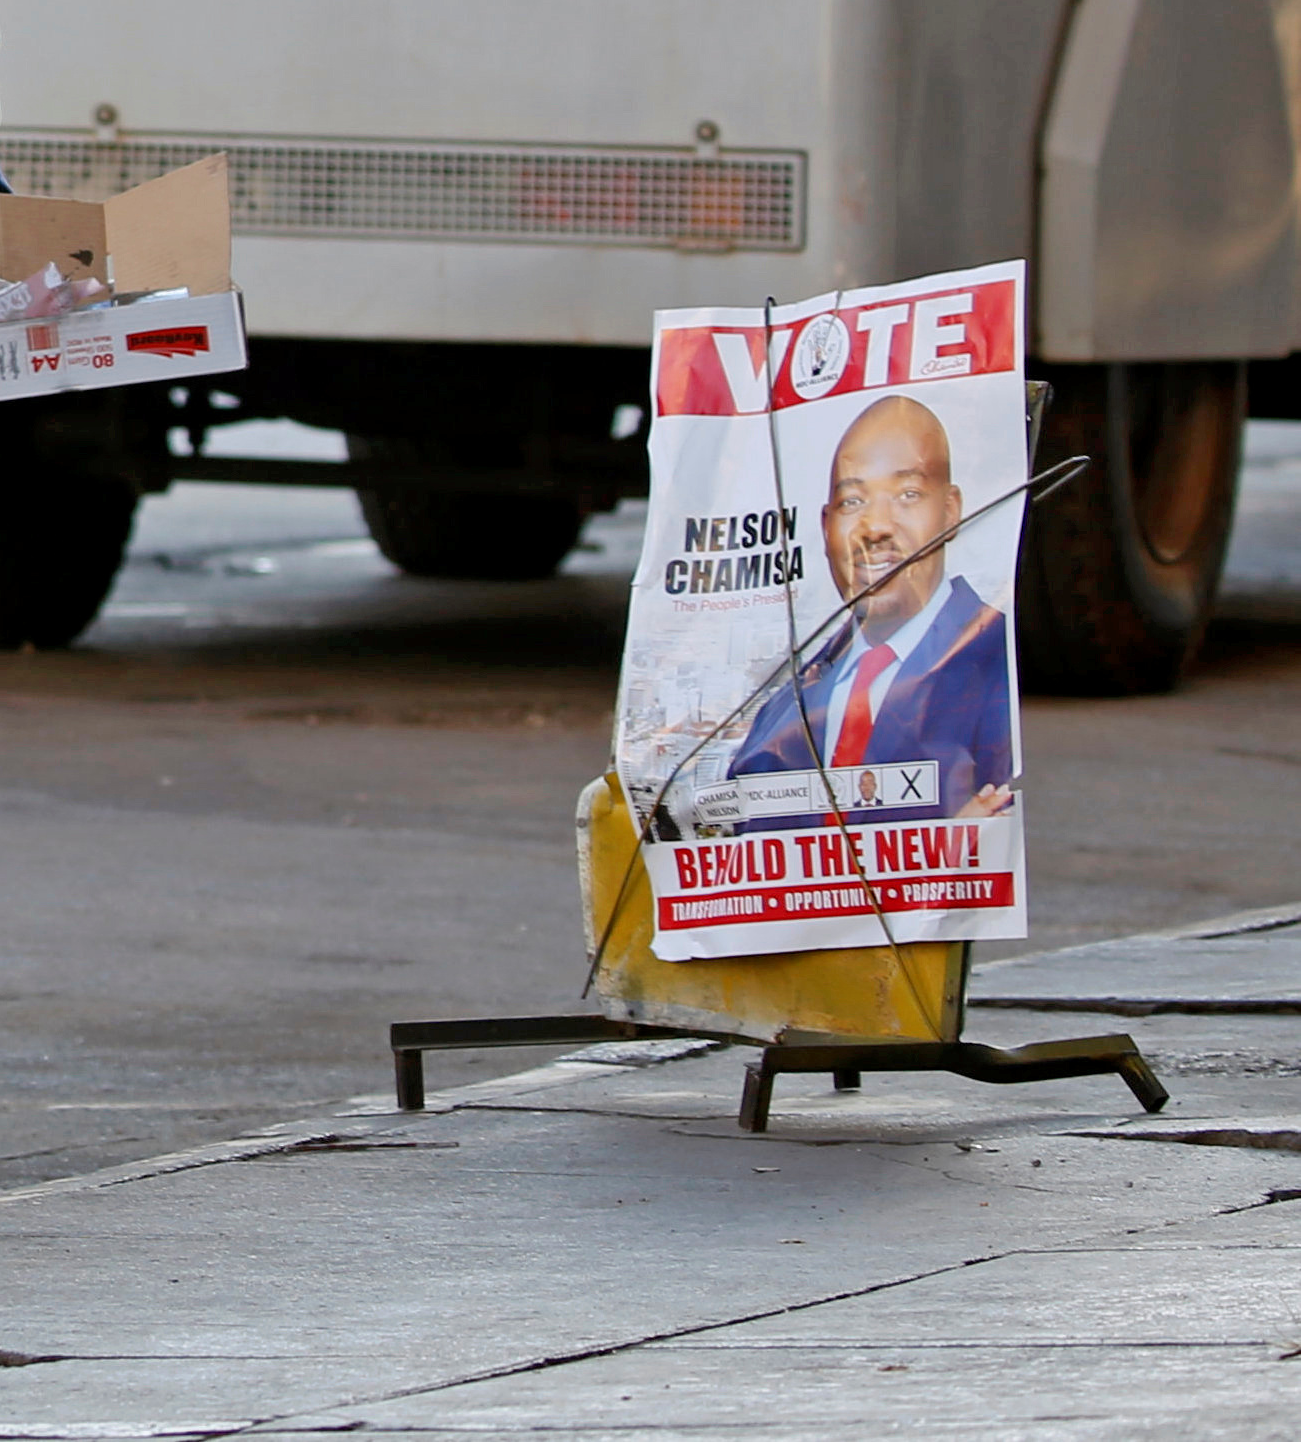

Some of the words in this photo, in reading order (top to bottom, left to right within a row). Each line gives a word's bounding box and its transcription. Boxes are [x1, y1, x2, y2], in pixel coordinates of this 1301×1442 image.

[31, 353, 62, 373] A4
[92, 353, 115, 369] 80
[712, 293, 974, 414] VOTE
[685, 506, 797, 552] NELSON
[665, 545, 804, 595] CHAMISA
[673, 600, 697, 613] The
[701, 596, 750, 613] People's
[698, 790, 739, 805] CHAMISA
[707, 806, 740, 817] NELSON
[794, 832, 865, 879] THE
[874, 825, 980, 873] NEW!
[674, 838, 787, 890] BEHOLD
[902, 880, 994, 903] PROSPERITY
